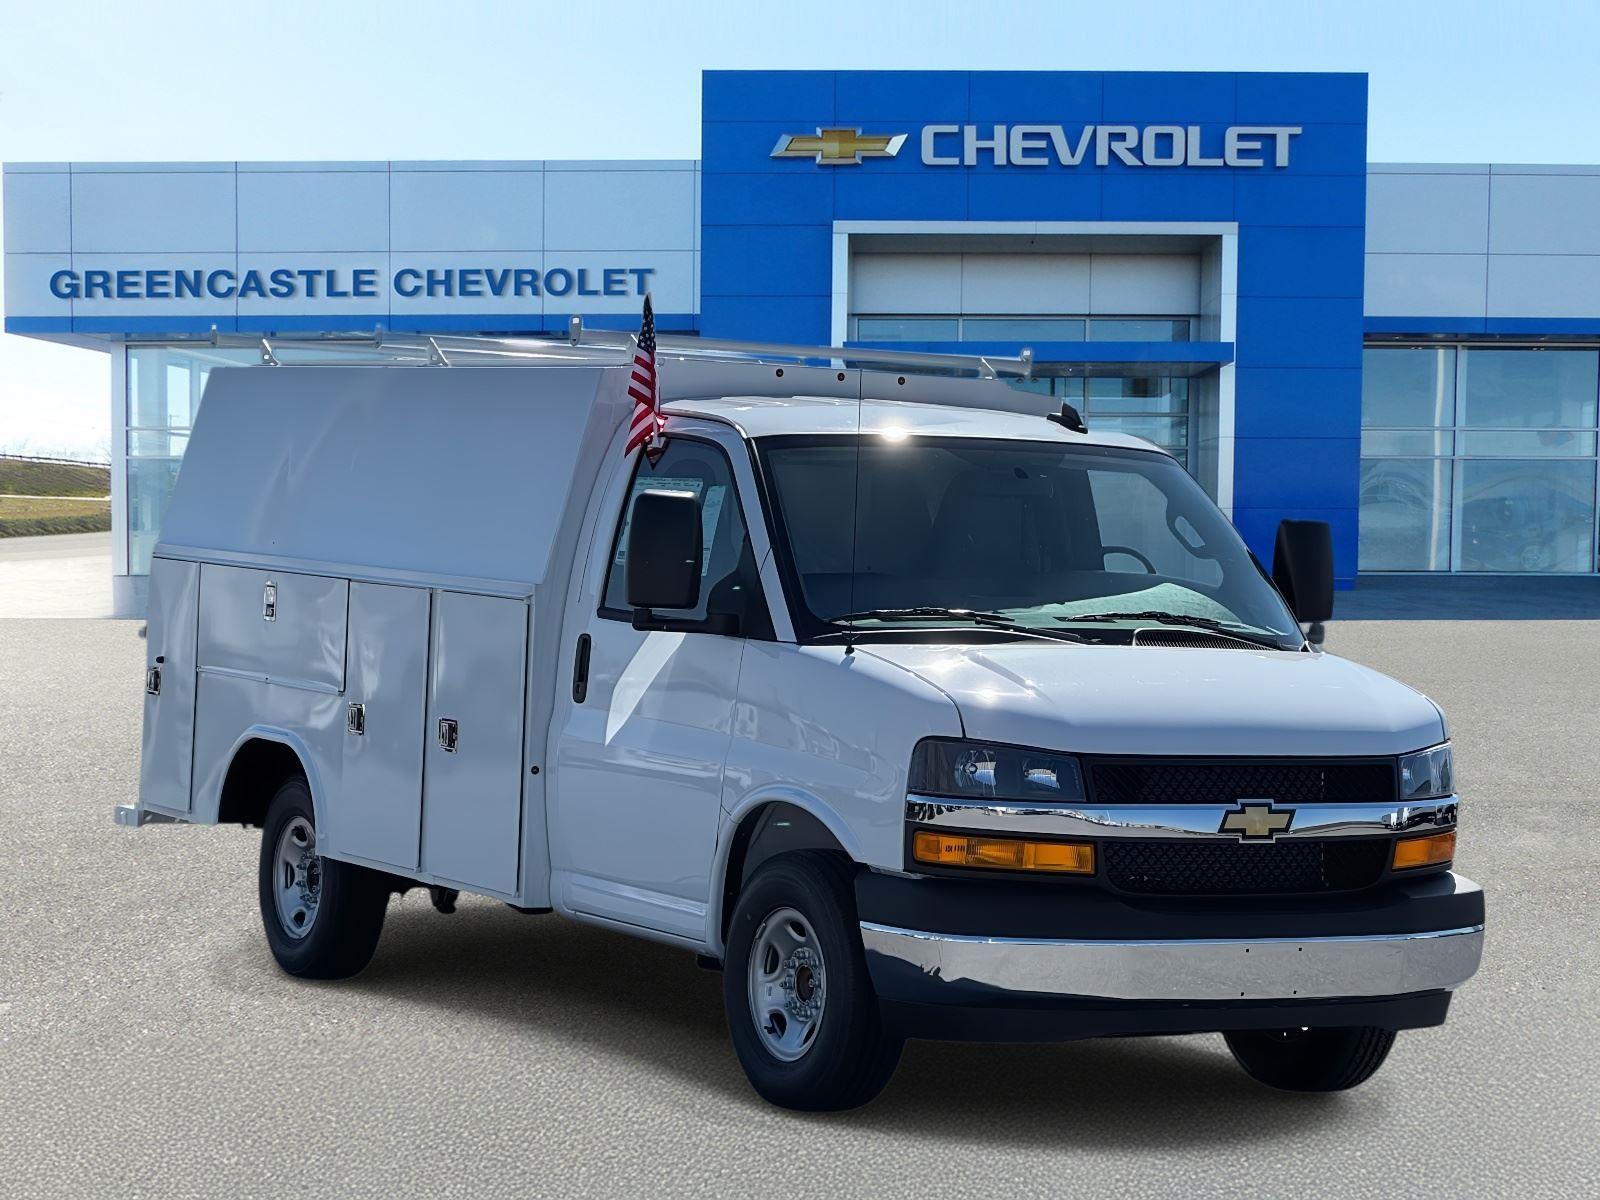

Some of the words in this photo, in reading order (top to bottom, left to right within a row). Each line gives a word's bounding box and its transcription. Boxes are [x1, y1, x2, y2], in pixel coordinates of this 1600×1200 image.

[921, 125, 1302, 167] CHEVROLET
[50, 269, 378, 299] GREENCASTLE
[393, 268, 655, 297] CHEVROLET
